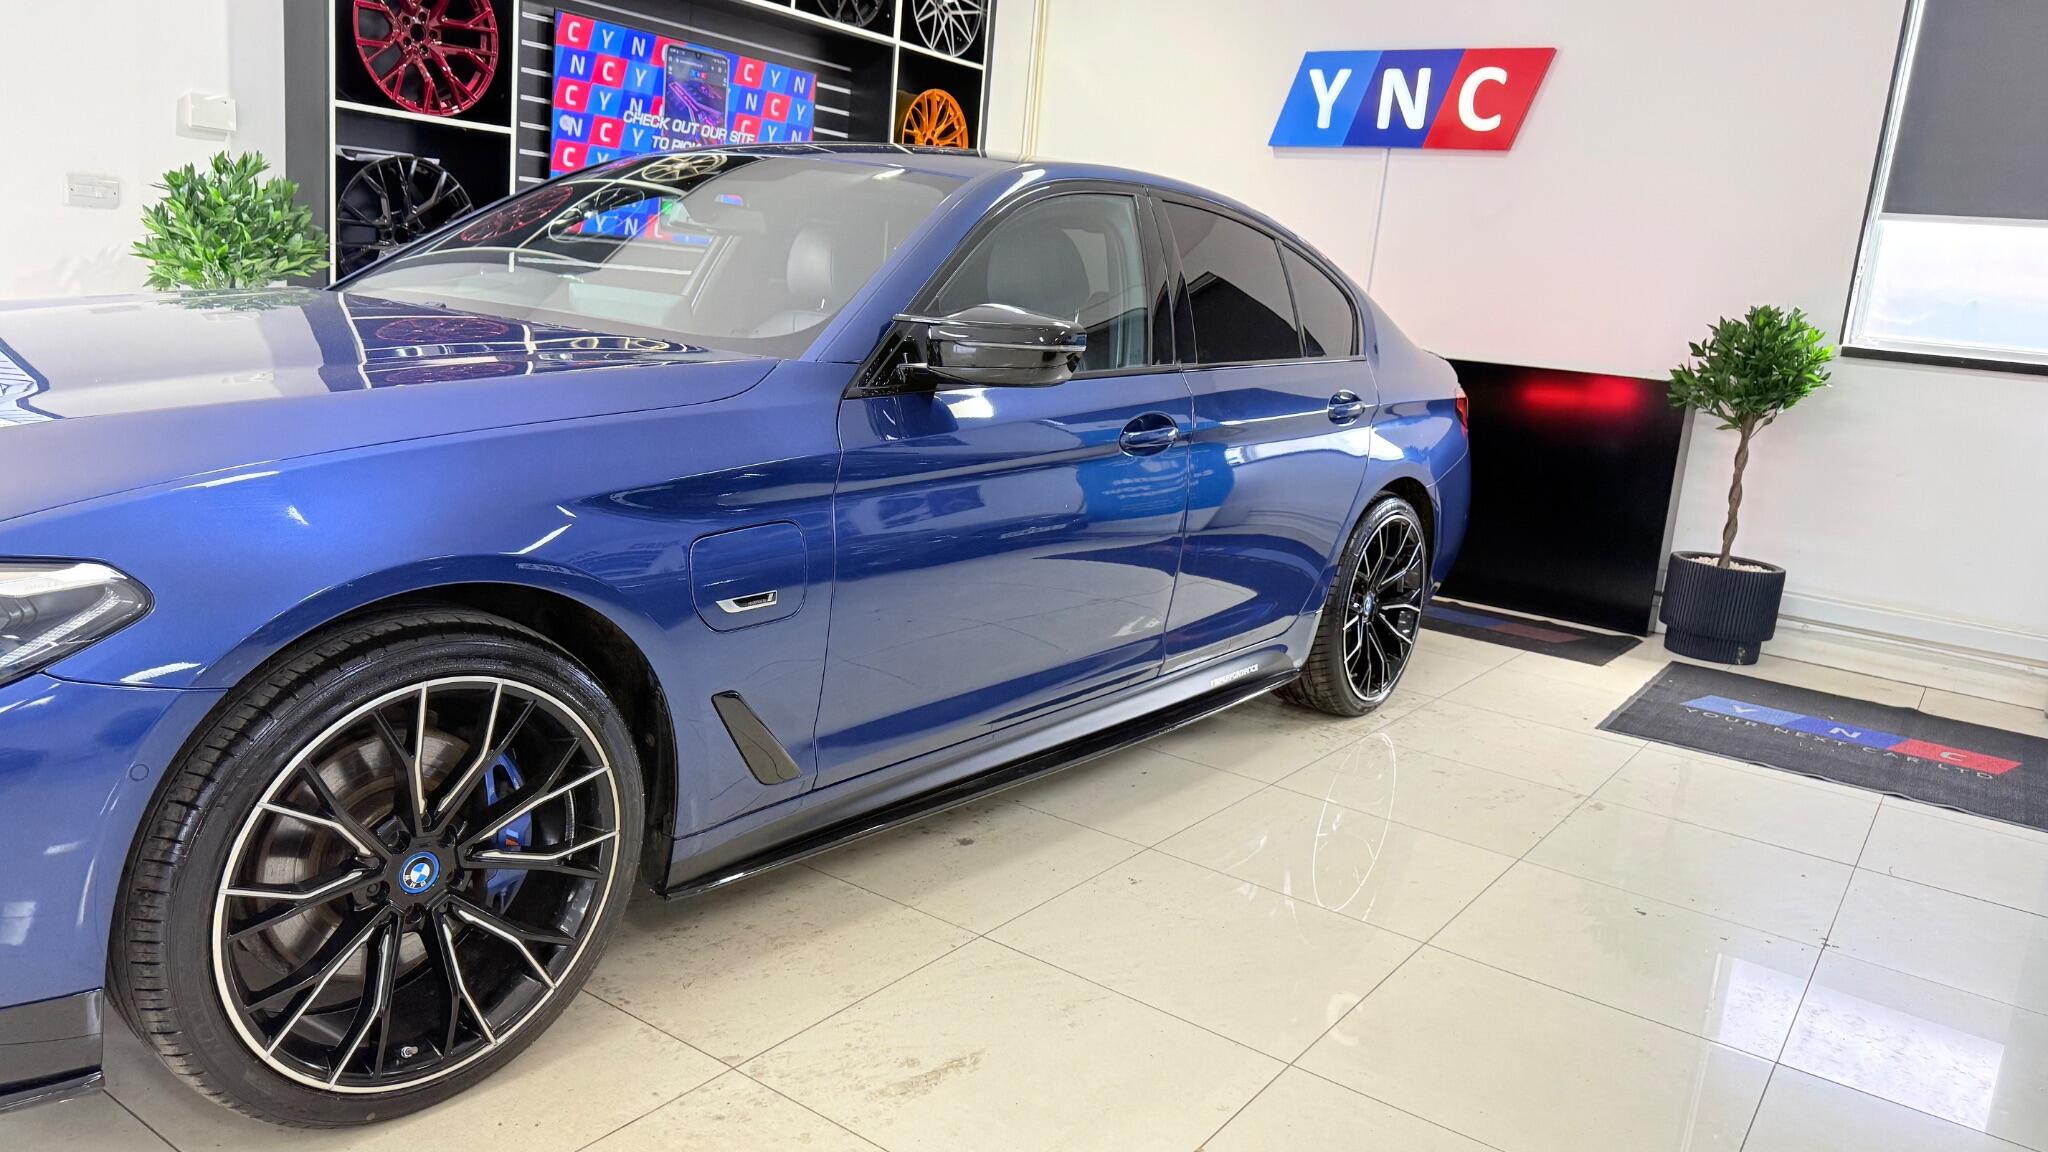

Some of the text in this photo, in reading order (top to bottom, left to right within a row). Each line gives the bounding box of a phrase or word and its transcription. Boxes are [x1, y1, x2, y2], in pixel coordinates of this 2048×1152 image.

[567, 21, 581, 42] C
[602, 28, 615, 49] Y
[631, 36, 646, 57] N
[743, 63, 755, 82] C
[771, 69, 781, 88] Y
[793, 75, 806, 94] N
[565, 85, 578, 106] C
[599, 90, 612, 111] Y
[569, 54, 807, 121] N C Y N C Y
[1309, 66, 1508, 132] YNC
[599, 122, 612, 142] C
[632, 127, 645, 147] Y
[623, 110, 755, 143] CHECK OUT OUR SITE
[652, 135, 669, 150] TO
[562, 147, 576, 167] C
[1685, 707, 1993, 780] YOUR NEXT CAR LTD
